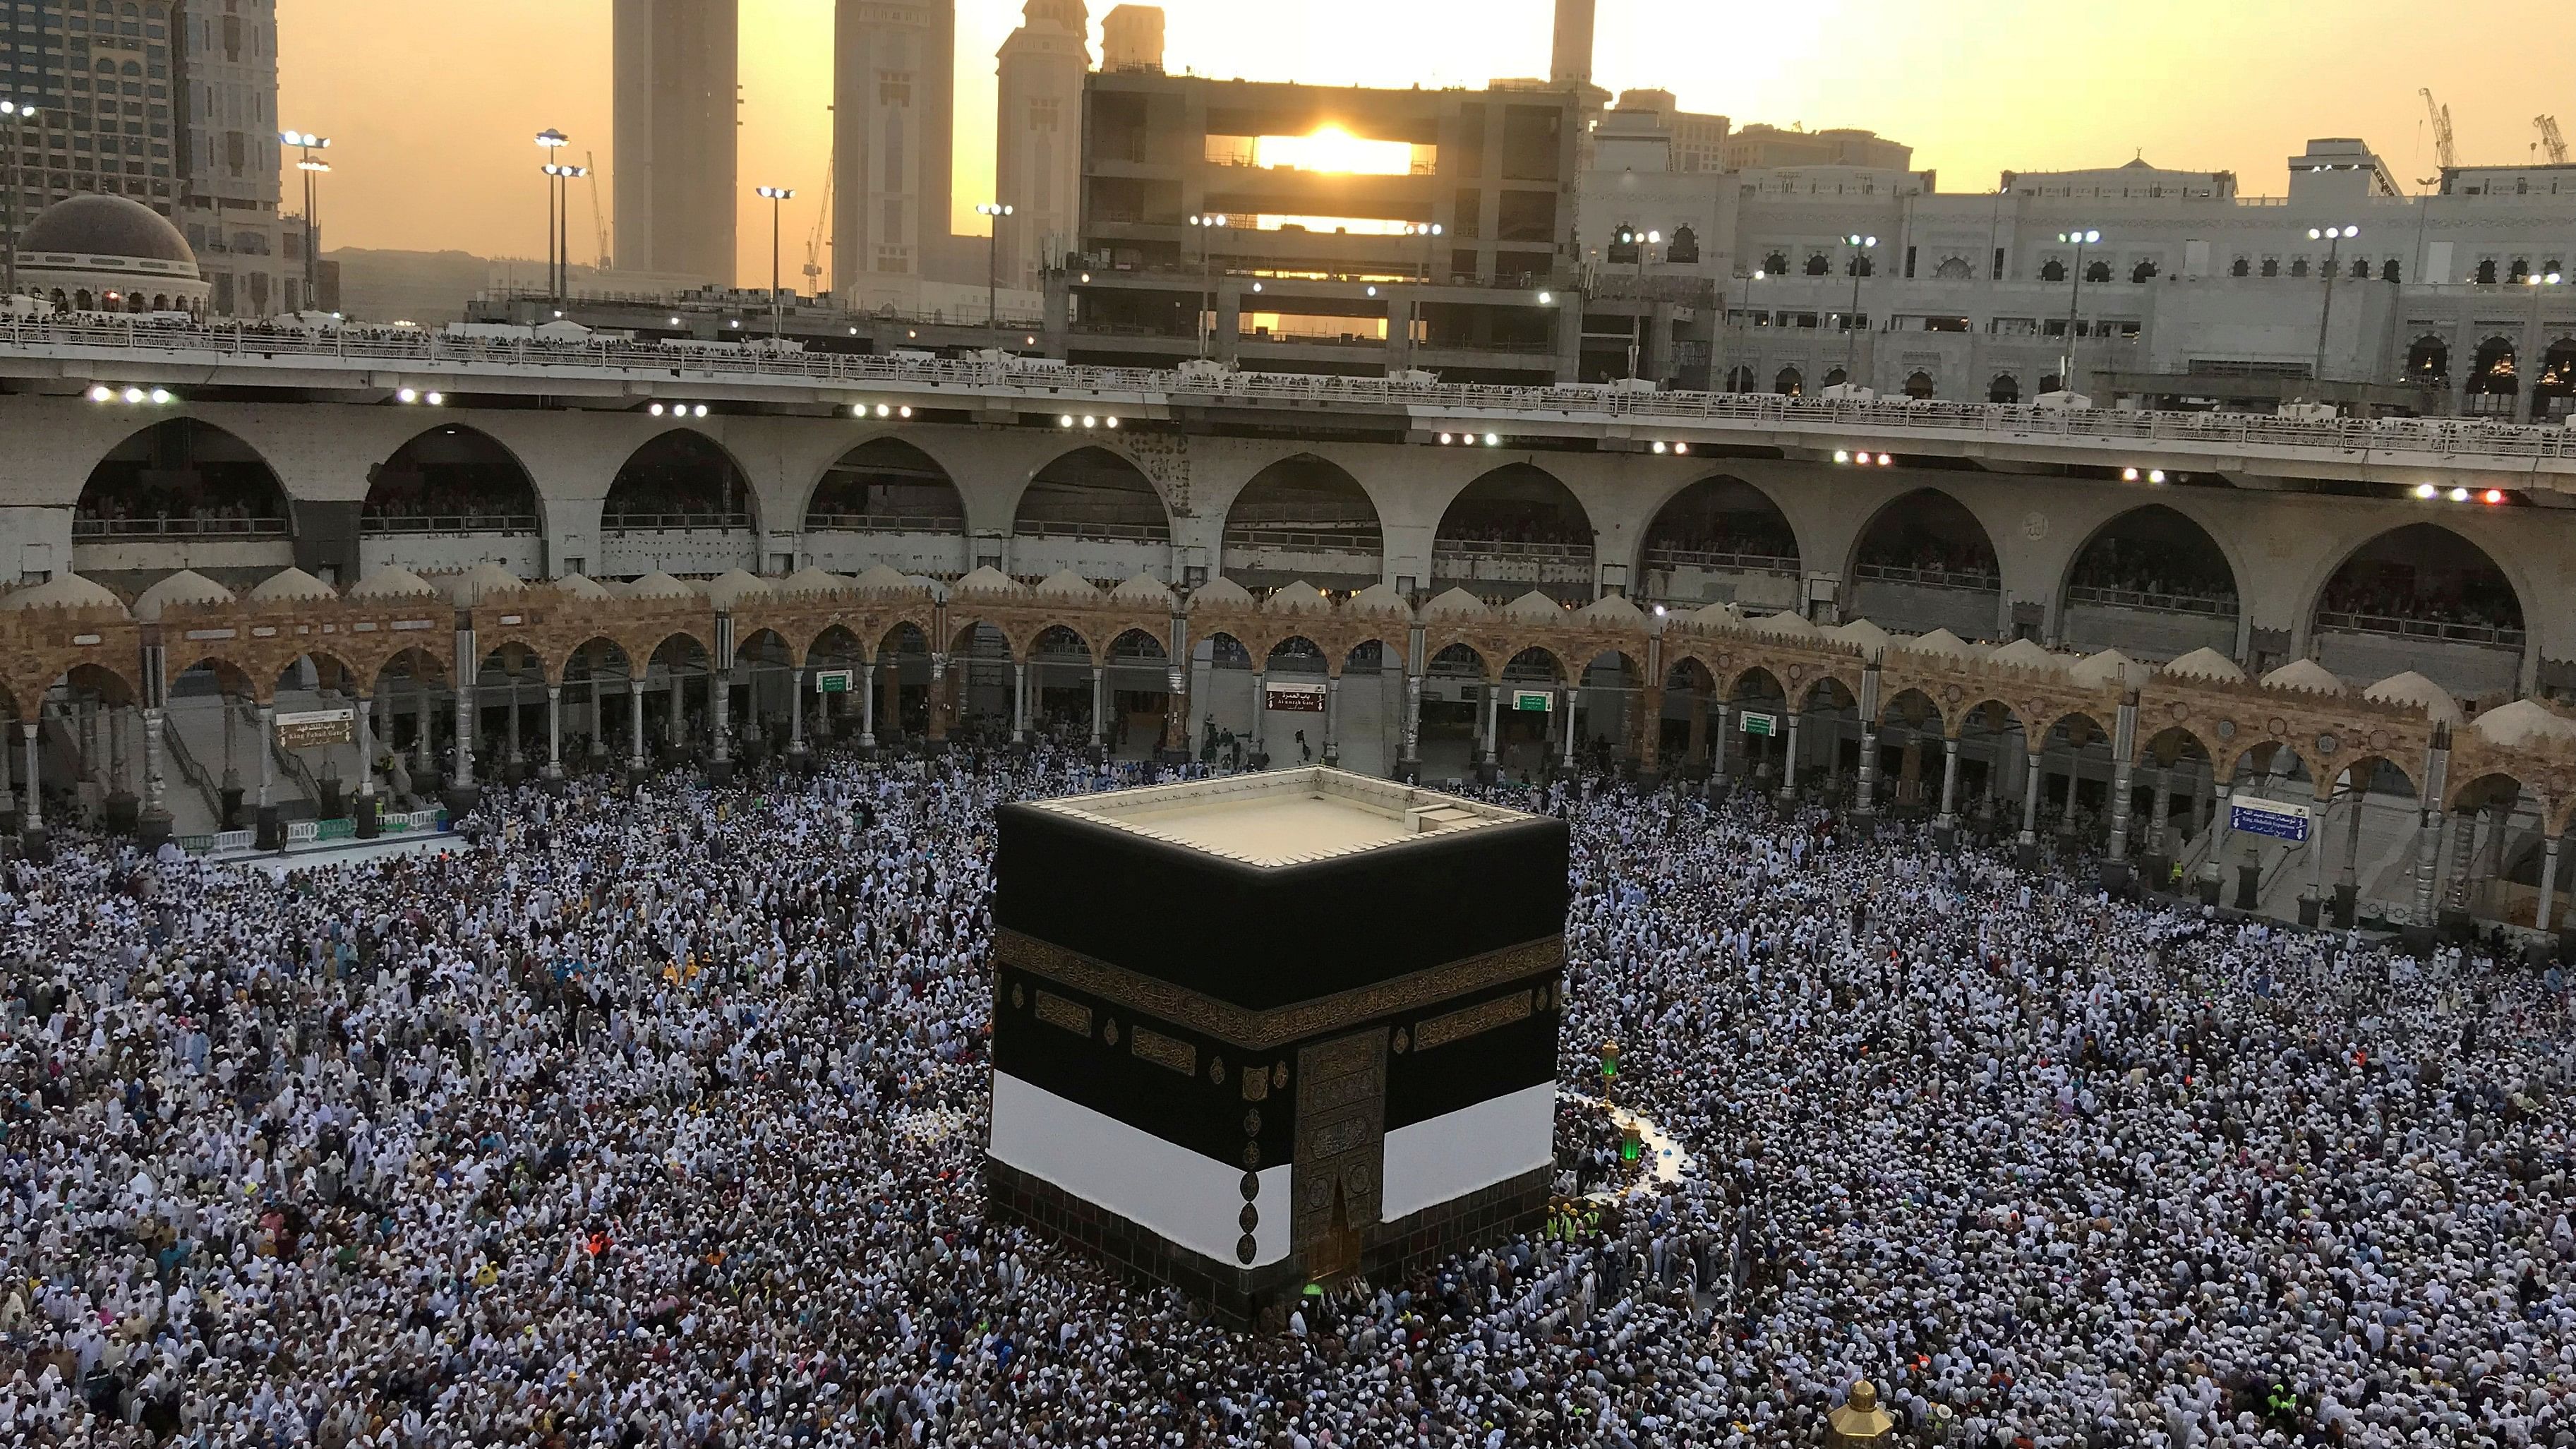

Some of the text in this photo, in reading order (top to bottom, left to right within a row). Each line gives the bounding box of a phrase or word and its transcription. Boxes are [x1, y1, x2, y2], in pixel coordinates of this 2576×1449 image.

[296, 724, 308, 733] فهد
[323, 722, 335, 730] باب
[2276, 814, 2297, 824] توسعة
